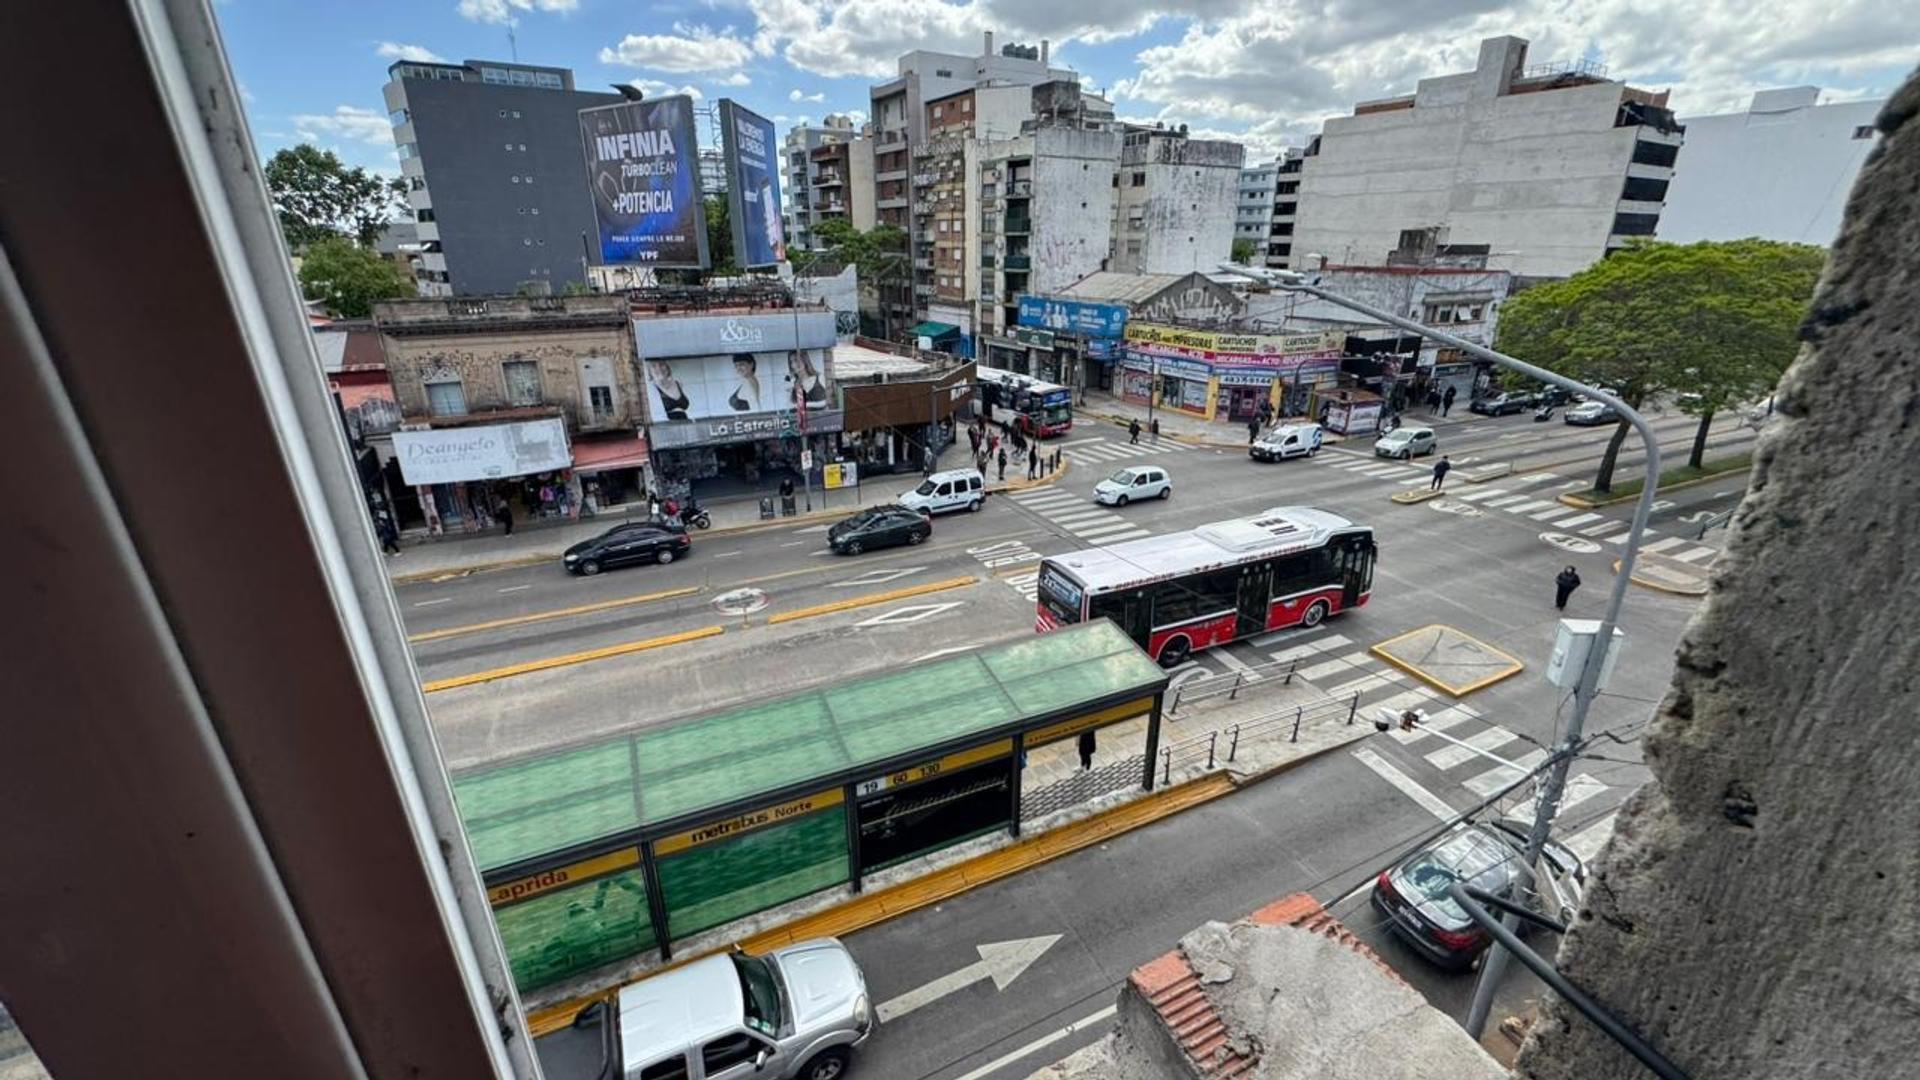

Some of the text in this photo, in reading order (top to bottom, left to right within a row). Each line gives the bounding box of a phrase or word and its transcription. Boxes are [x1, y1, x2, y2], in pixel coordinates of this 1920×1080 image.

[596, 129, 676, 160] INFINIA
[621, 160, 678, 177] TURBOCLEAN
[612, 190, 674, 214] +POTENCIA
[640, 250, 659, 260] YPF
[1217, 336, 1257, 346] CARTUCHOS
[1284, 335, 1320, 346] CARTUCHOS
[709, 423, 728, 436] La
[734, 417, 790, 434] Estrella
[863, 763, 940, 794] 19 60 130
[691, 801, 812, 842] metrobus Norte
[490, 871, 568, 903] aprida
